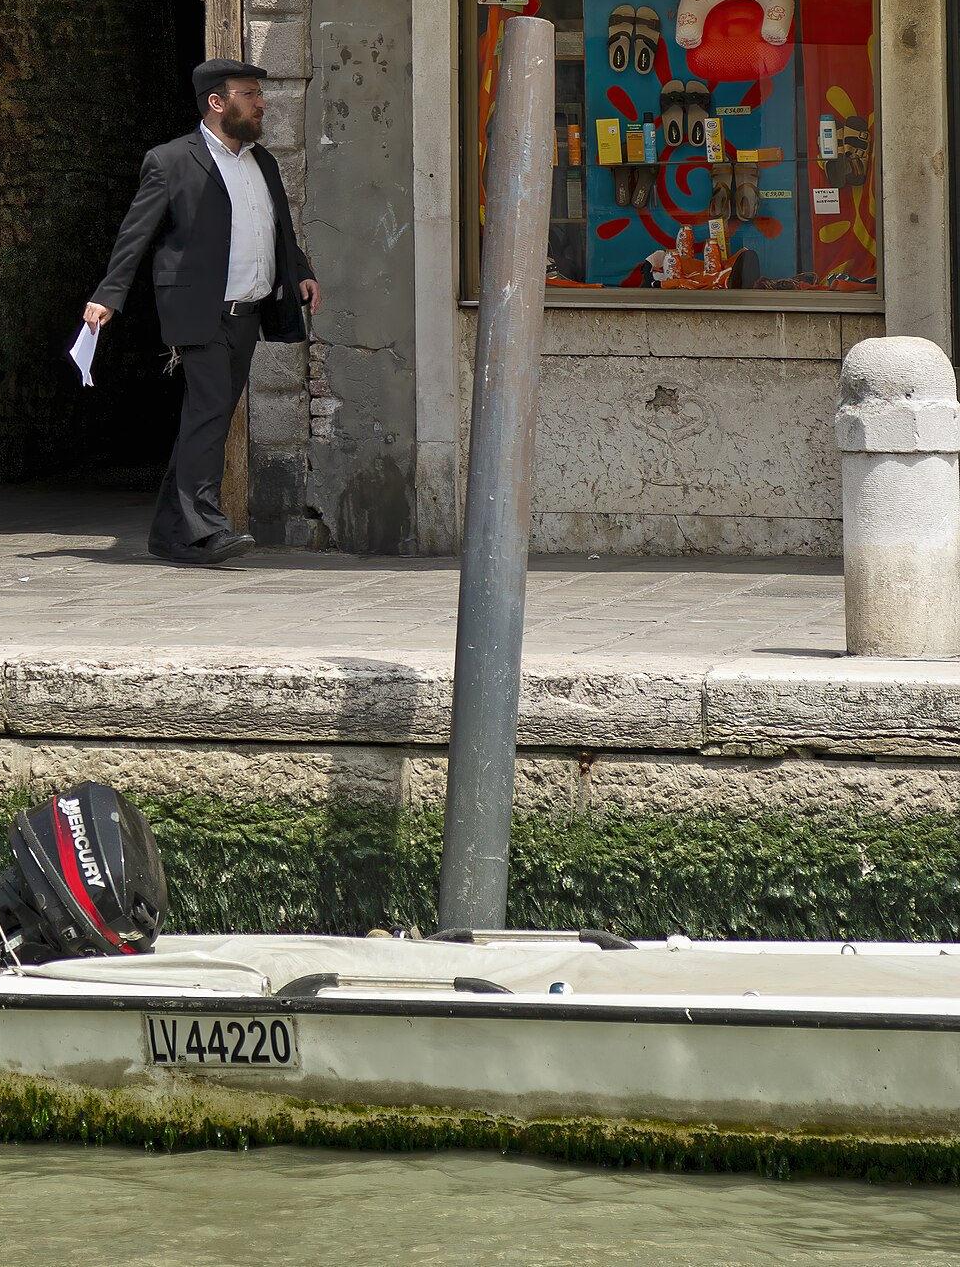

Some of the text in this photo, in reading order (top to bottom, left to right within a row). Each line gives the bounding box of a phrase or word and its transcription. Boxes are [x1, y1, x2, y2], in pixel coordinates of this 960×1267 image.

[58, 798, 106, 888] MERCURY
[148, 1018, 291, 1064] LV 44220
